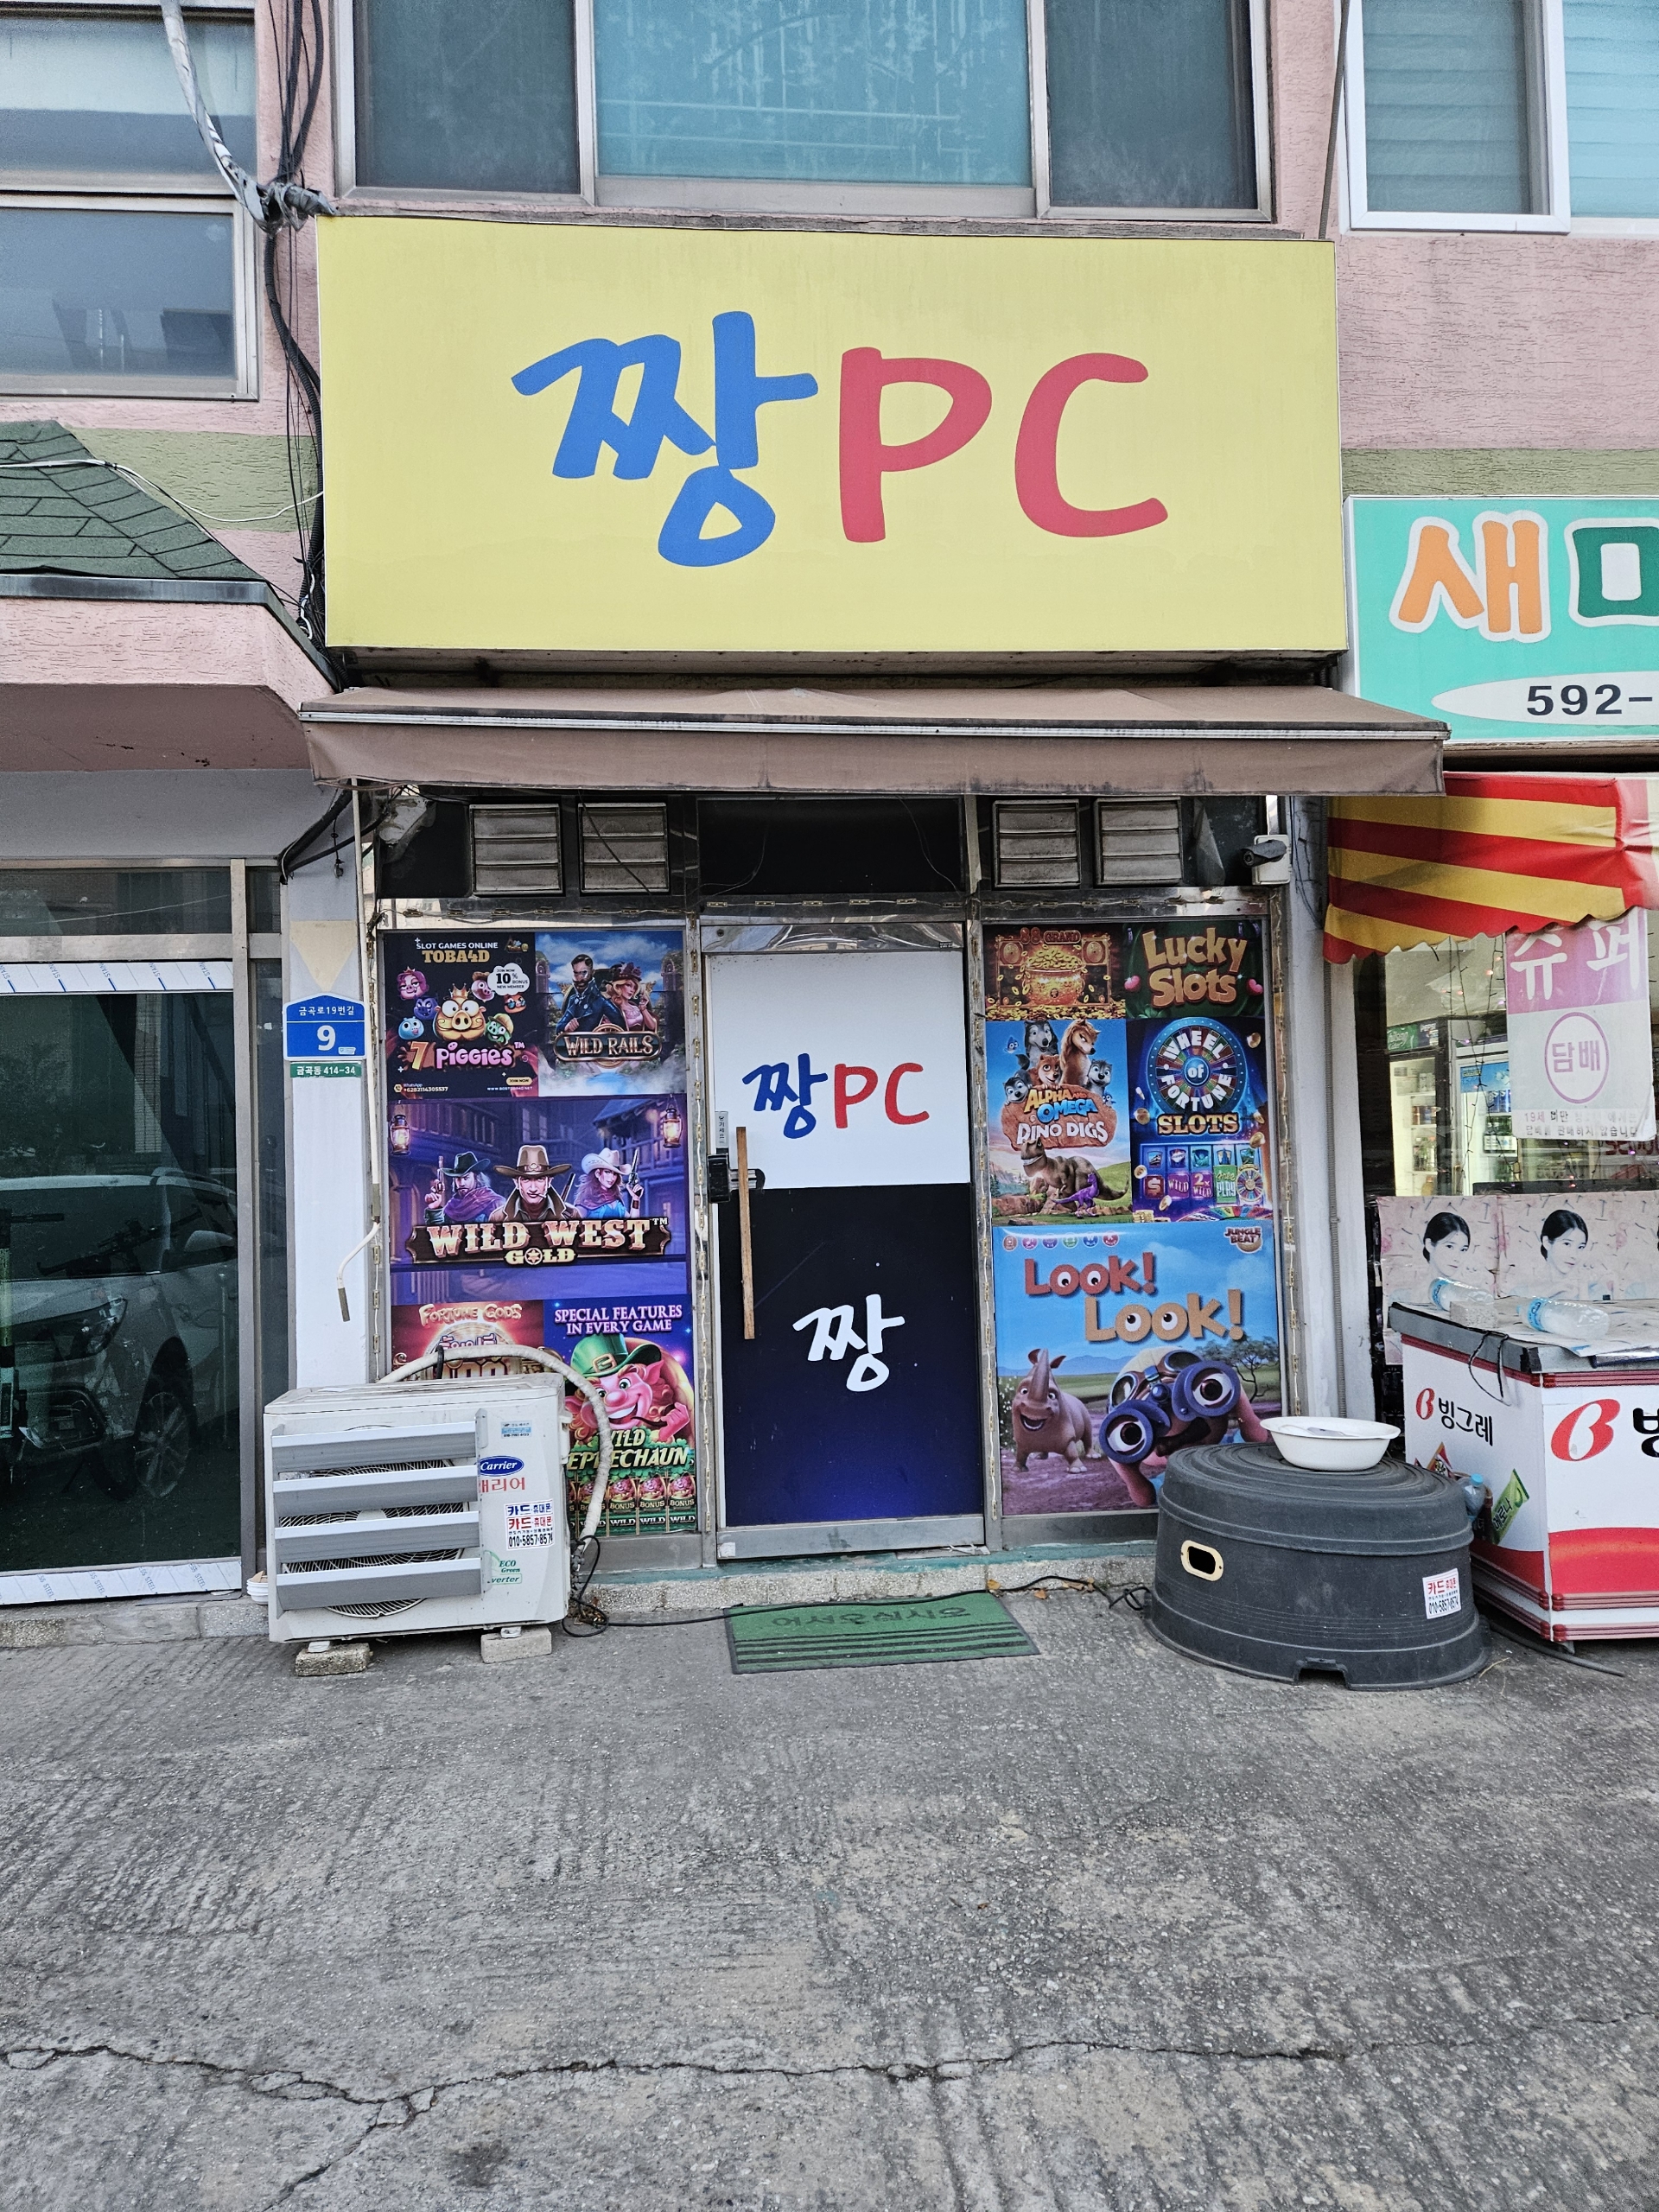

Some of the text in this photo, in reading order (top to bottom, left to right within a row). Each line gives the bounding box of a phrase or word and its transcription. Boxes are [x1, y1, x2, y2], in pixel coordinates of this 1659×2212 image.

[1045, 931, 1079, 943] GRAND
[422, 950, 490, 963] TOBA4D
[1141, 926, 1247, 973] Lucky
[1148, 968, 1237, 1007] Slots
[298, 1006, 354, 1016] 금곡로19번길
[317, 1025, 336, 1051] 9
[563, 1034, 653, 1057] WILD RAILS
[1162, 1030, 1224, 1059] WHEEL
[410, 1041, 429, 1071] 7
[1552, 1040, 1600, 1073] 담배
[296, 1065, 355, 1076] 금곡동 414-34
[1024, 1089, 1073, 1113] ALPHA
[1161, 1074, 1232, 1111] FORTUNE
[1037, 1099, 1098, 1122] OMEGA
[1017, 1122, 1109, 1145] DINO DIGS
[1158, 1114, 1238, 1135] SLOTS
[1168, 1179, 1189, 1192] WILD
[1192, 1185, 1211, 1198] WILD
[427, 1222, 531, 1258] WILD
[544, 1219, 651, 1250] WEST
[1224, 1227, 1262, 1238] JUNGLE
[1230, 1235, 1257, 1244] BEAT
[418, 1303, 522, 1326] FORTUNE GODS
[555, 1305, 683, 1324] SPECIAL FEATURES
[566, 1319, 672, 1335] IN EVERY GAME
[792, 1294, 906, 1392] 짱
[1438, 1400, 1492, 1446] 빙그레
[610, 1428, 646, 1447] ILD
[480, 1460, 518, 1471] Carrier
[567, 1447, 690, 1470] EPECHAUN
[610, 1518, 636, 1527] WILD
[640, 1516, 666, 1525] WILD
[671, 1515, 696, 1523] WILD
